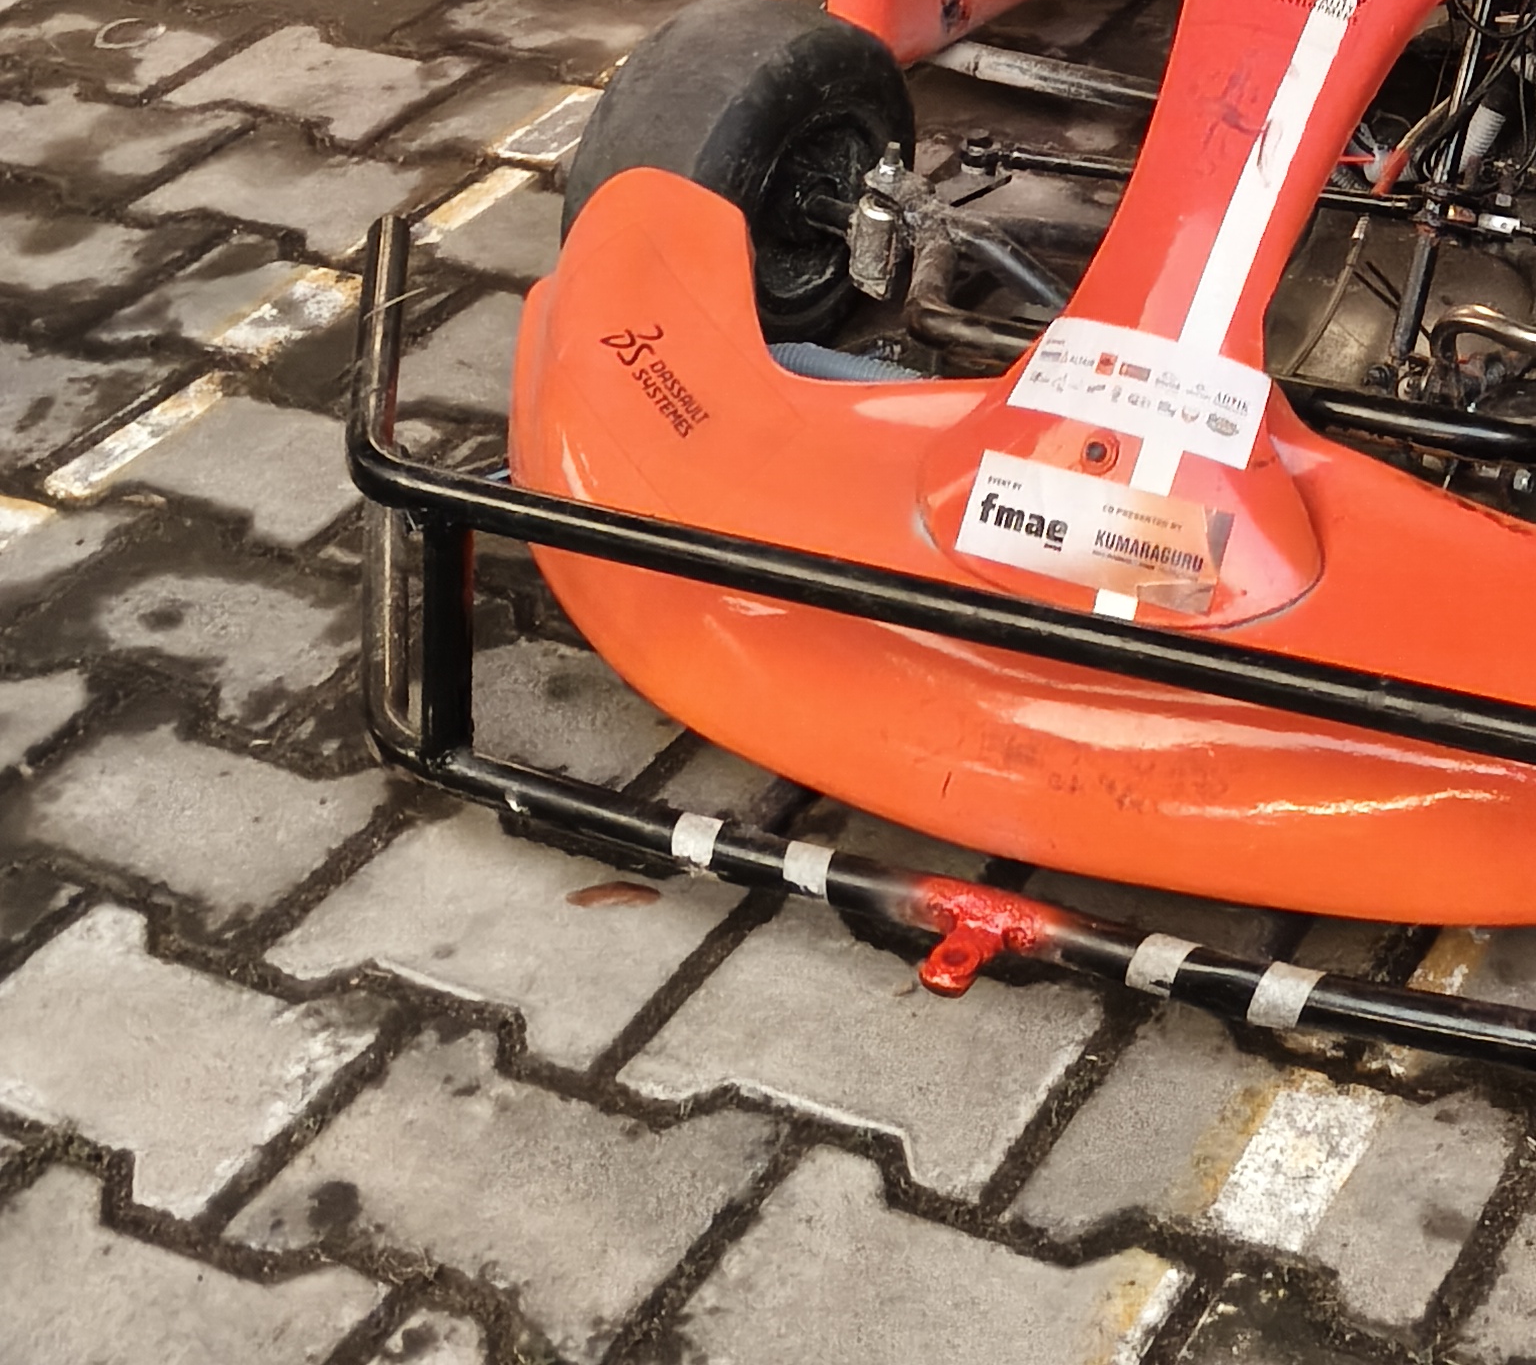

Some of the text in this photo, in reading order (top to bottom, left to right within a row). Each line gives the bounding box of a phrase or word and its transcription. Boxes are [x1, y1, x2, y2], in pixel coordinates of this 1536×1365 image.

[631, 368, 694, 439] SYSTEMES
[649, 359, 710, 425] DASSAULT
[979, 492, 1069, 544] fmae
[1094, 528, 1205, 573] KUMARAGURU
